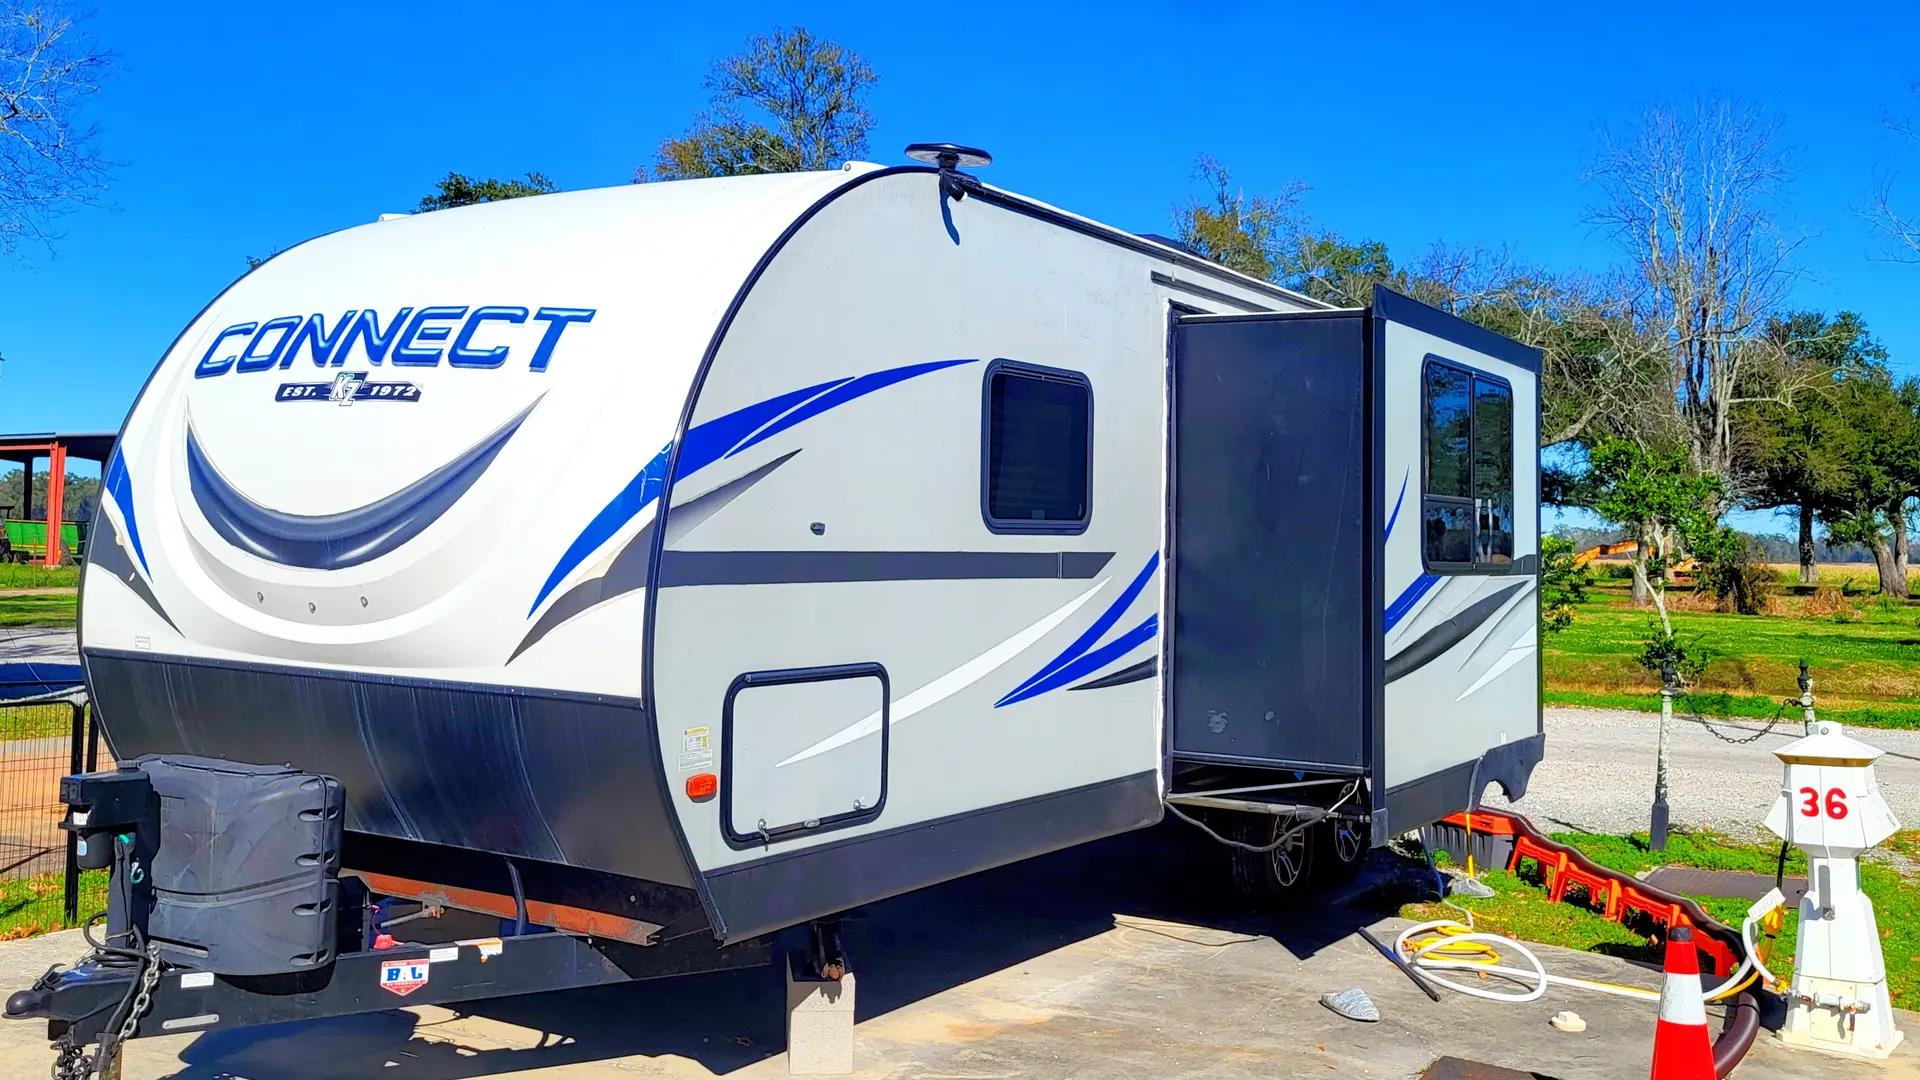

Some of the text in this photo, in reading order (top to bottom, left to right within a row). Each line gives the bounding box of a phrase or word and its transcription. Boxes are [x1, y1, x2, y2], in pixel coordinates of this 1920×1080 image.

[195, 305, 597, 379] CONNECT
[282, 386, 317, 397] EST.
[370, 385, 417, 396] 1972
[1800, 786, 1848, 820] 36
